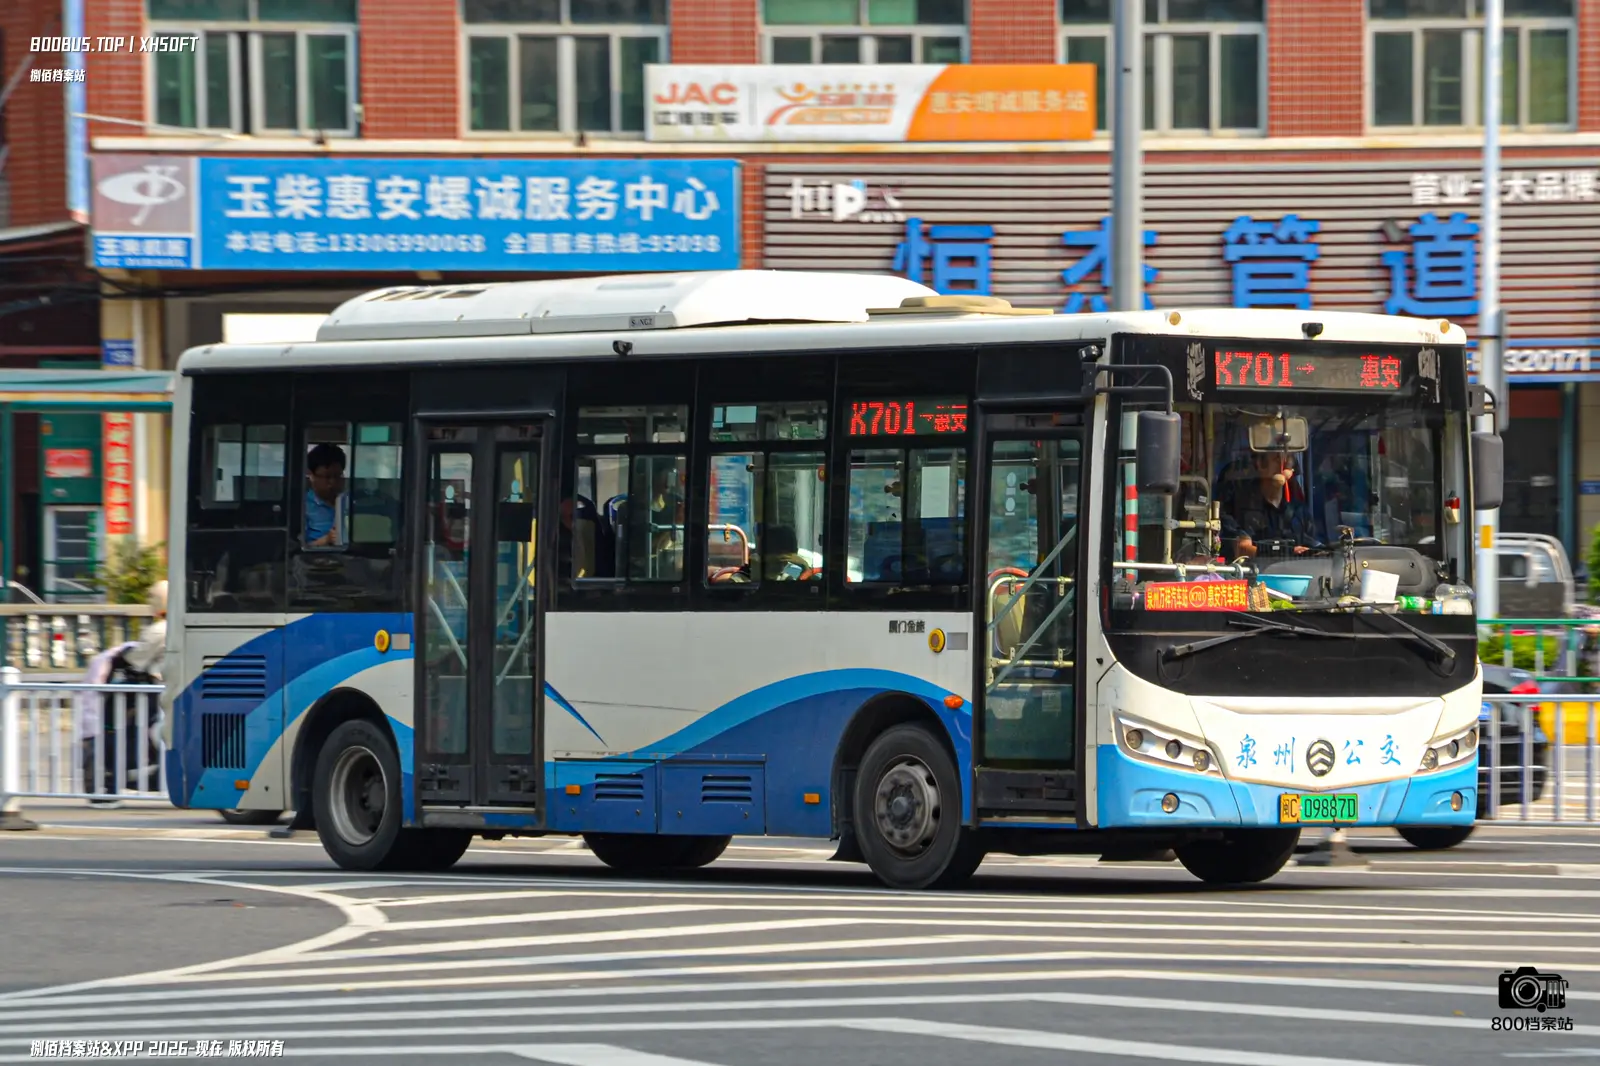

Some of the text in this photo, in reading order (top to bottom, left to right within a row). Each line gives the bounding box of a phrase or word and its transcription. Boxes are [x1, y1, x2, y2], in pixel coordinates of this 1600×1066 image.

[654, 83, 739, 105] JAC
[225, 173, 720, 222] 玉柴惠安螺诚服务中心
[1215, 351, 1400, 387] K701 惠安
[850, 402, 916, 434] K701
[1236, 734, 1401, 774] 泉州 公交
